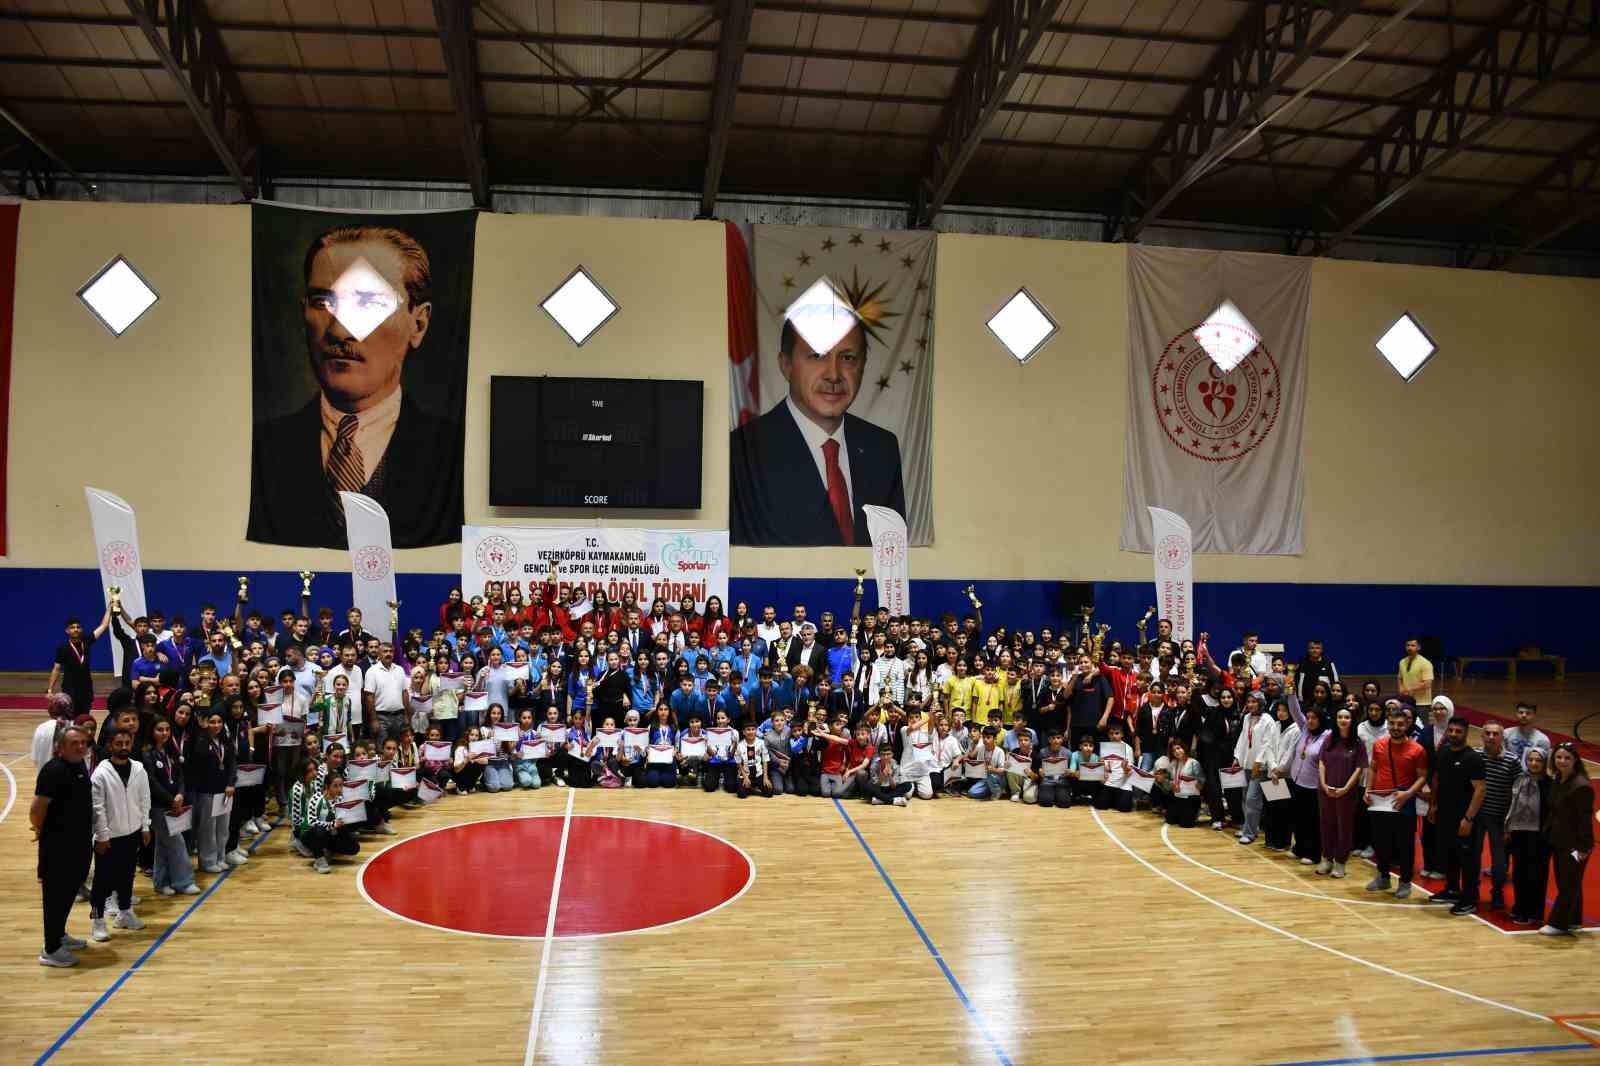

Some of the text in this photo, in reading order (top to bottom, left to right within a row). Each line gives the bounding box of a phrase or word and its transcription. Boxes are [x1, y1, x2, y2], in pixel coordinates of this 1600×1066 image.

[584, 495, 608, 505] SCORE
[586, 537, 600, 548] T.C.
[538, 548, 647, 562] VEZİRKÖPRÜ KAYMAKAMLIĞI
[523, 562, 660, 577] GENÇLİ ve SPOR İLÇE MÜDÜRLÜĞÜ
[528, 580, 604, 603] SPARI
[607, 577, 648, 603] ÖDÜL
[652, 577, 707, 603] TÖRENİ
